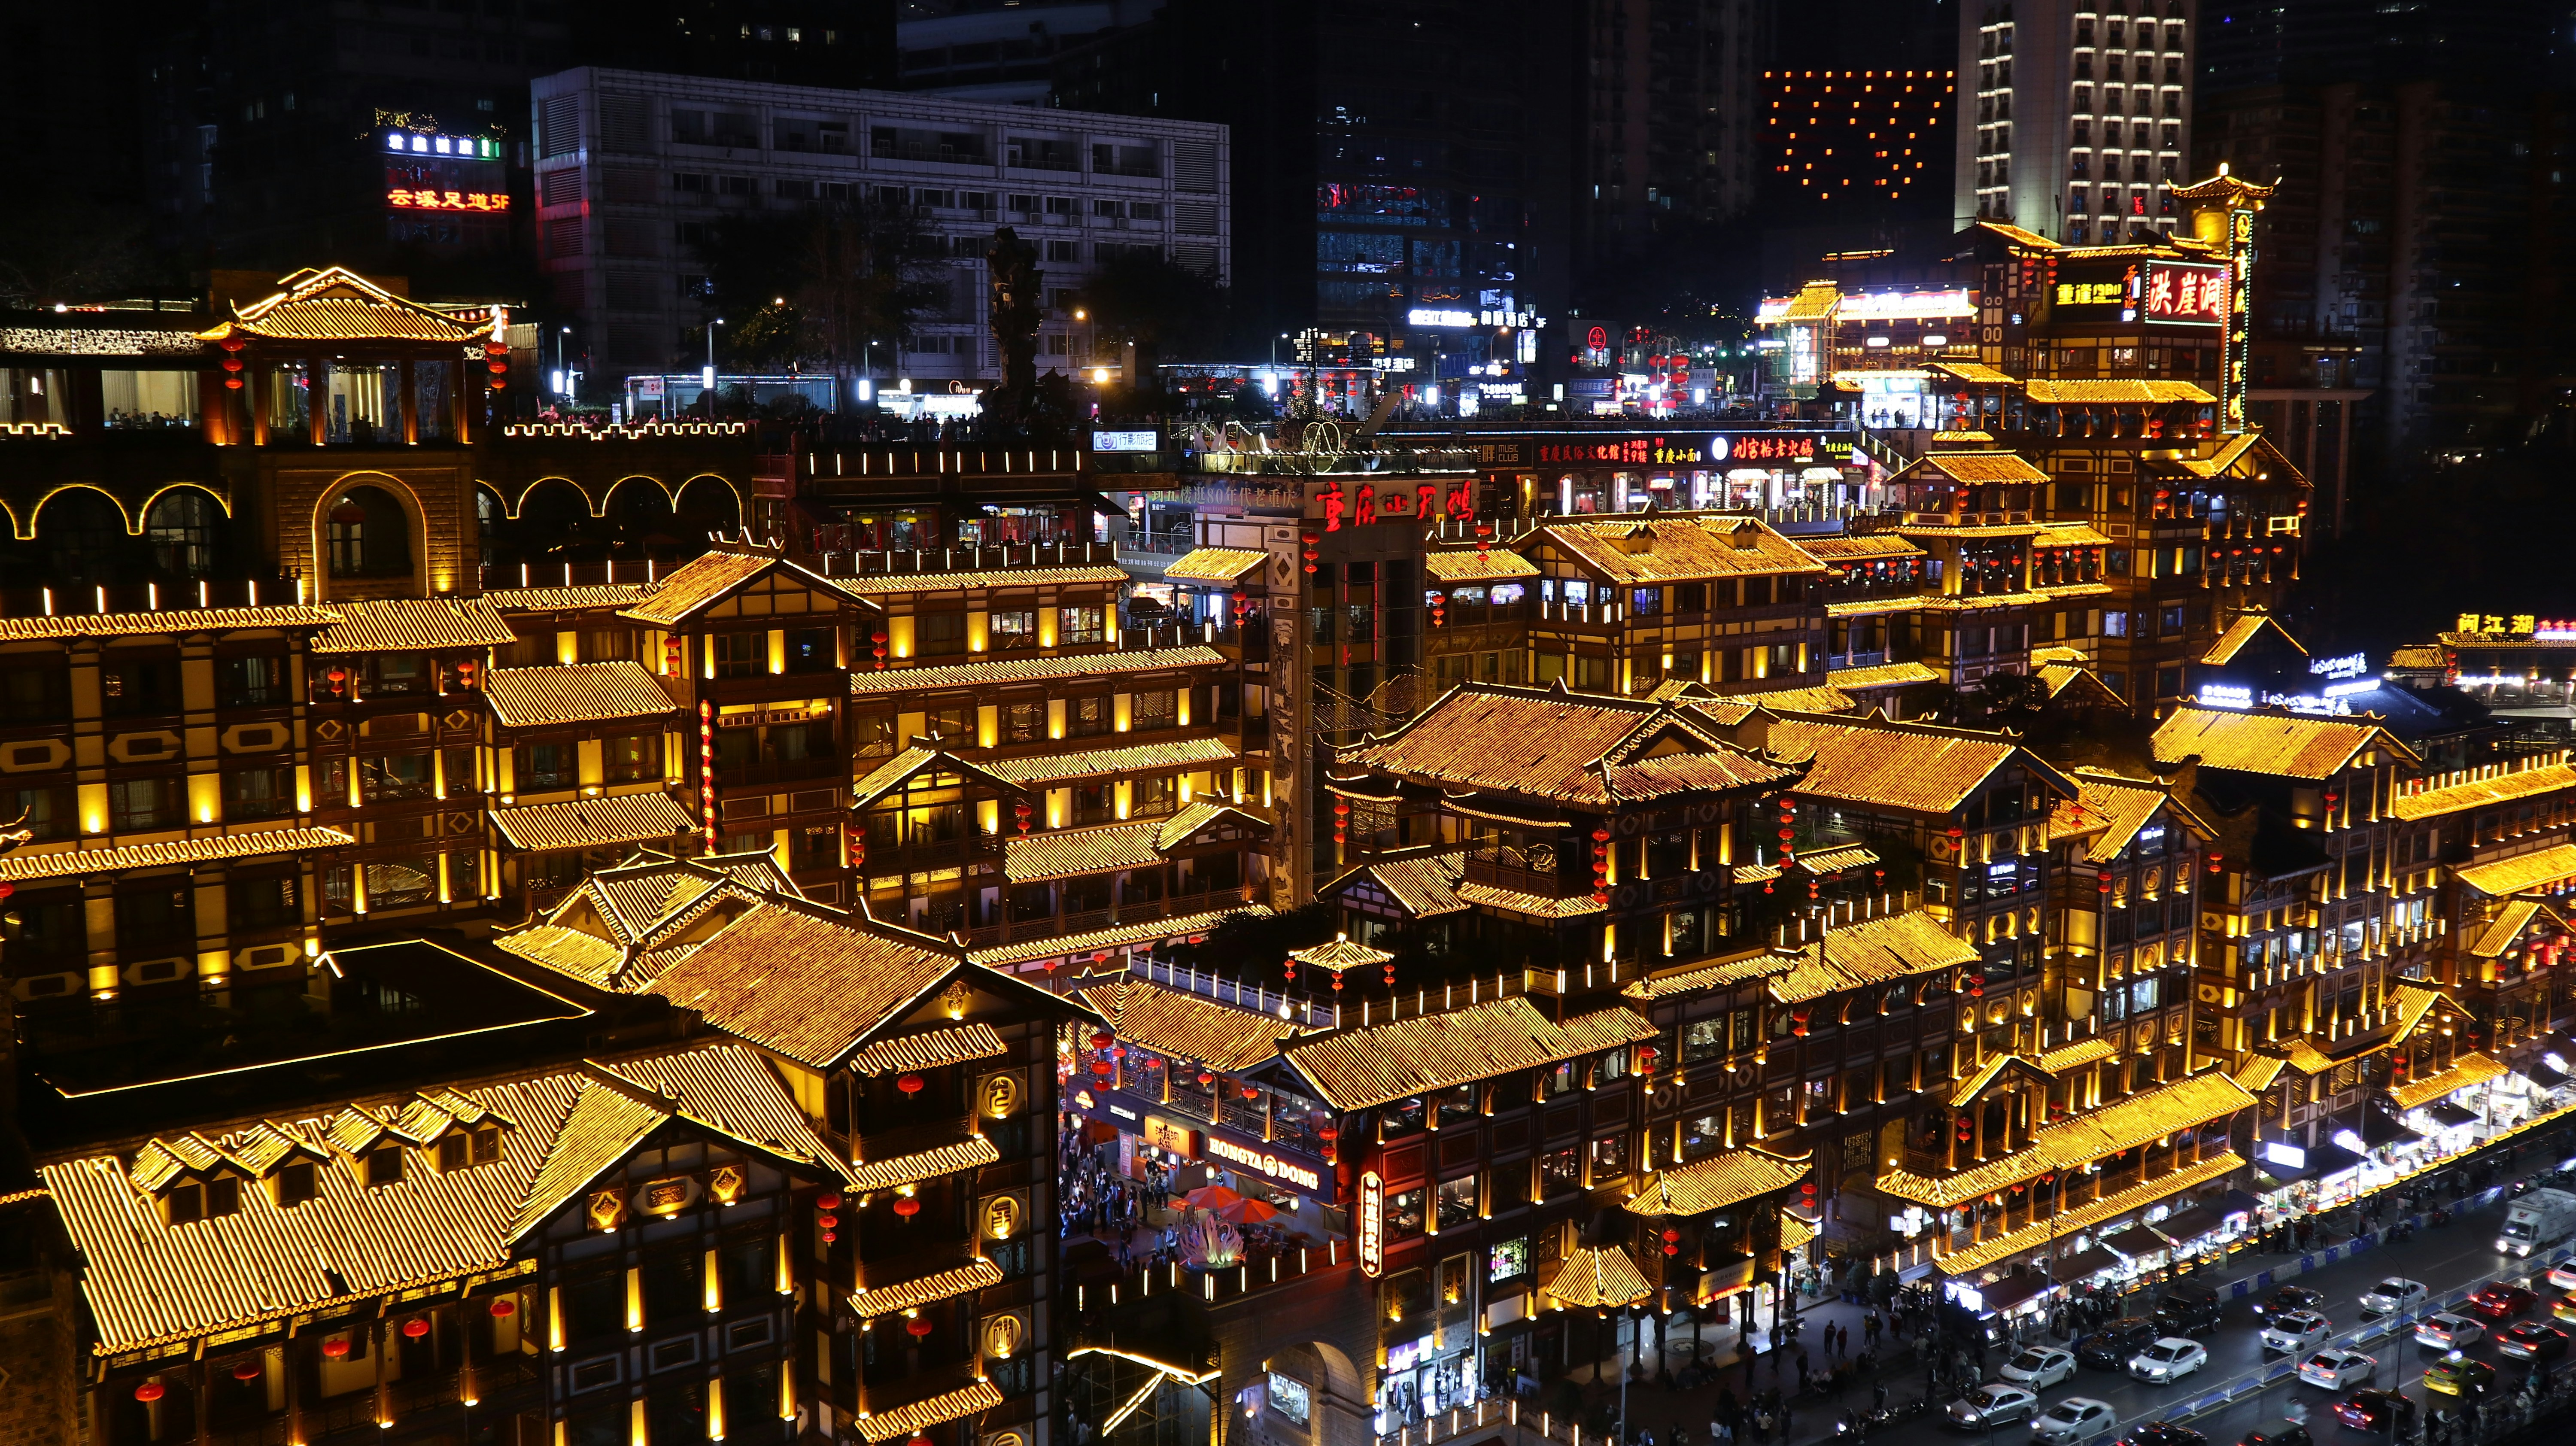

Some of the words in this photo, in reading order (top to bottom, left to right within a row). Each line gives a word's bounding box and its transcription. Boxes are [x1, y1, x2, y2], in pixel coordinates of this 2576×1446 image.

[2149, 270, 2221, 316] 洪崖洞
[1481, 310, 1528, 327] 和颐酒店
[1536, 317, 1546, 328] 3F
[1118, 433, 1154, 445] 行影旅拍
[1498, 444, 1519, 453] MUSIC
[1631, 450, 1647, 463] 9楼
[1654, 447, 1696, 464] 重慶小面
[1732, 437, 1814, 460] 九宫格老火锅
[1498, 453, 1519, 462] CLUB
[1152, 485, 1296, 509] 到五楼逛80年代老重庆
[1315, 481, 1474, 532] 重庆小天鹅
[1155, 1126, 1179, 1142] 洪崖洞
[1158, 1138, 1172, 1150] 火锅
[1209, 1138, 1264, 1171] HONGYA
[1278, 1161, 1318, 1190] DONG
